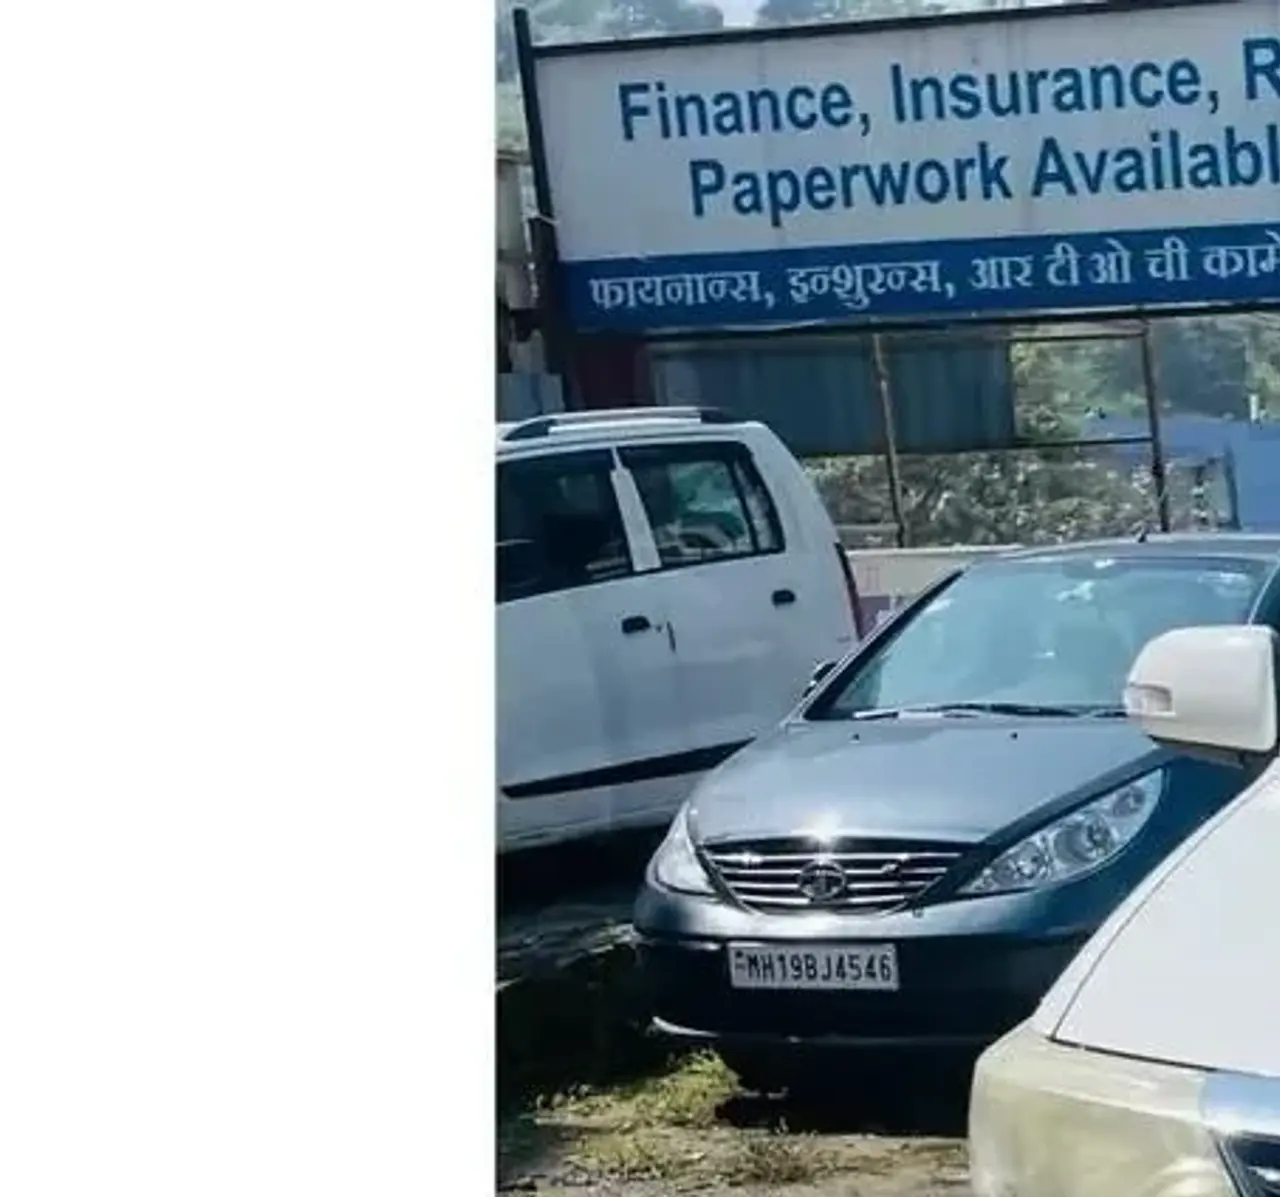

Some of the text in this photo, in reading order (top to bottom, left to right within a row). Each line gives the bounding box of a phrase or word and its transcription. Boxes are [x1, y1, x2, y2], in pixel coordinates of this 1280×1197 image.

[618, 81, 871, 141] Finance,
[890, 63, 1220, 122] Insurance,
[689, 141, 1013, 227] Paperwork
[747, 953, 892, 981] MH19BJ4546
